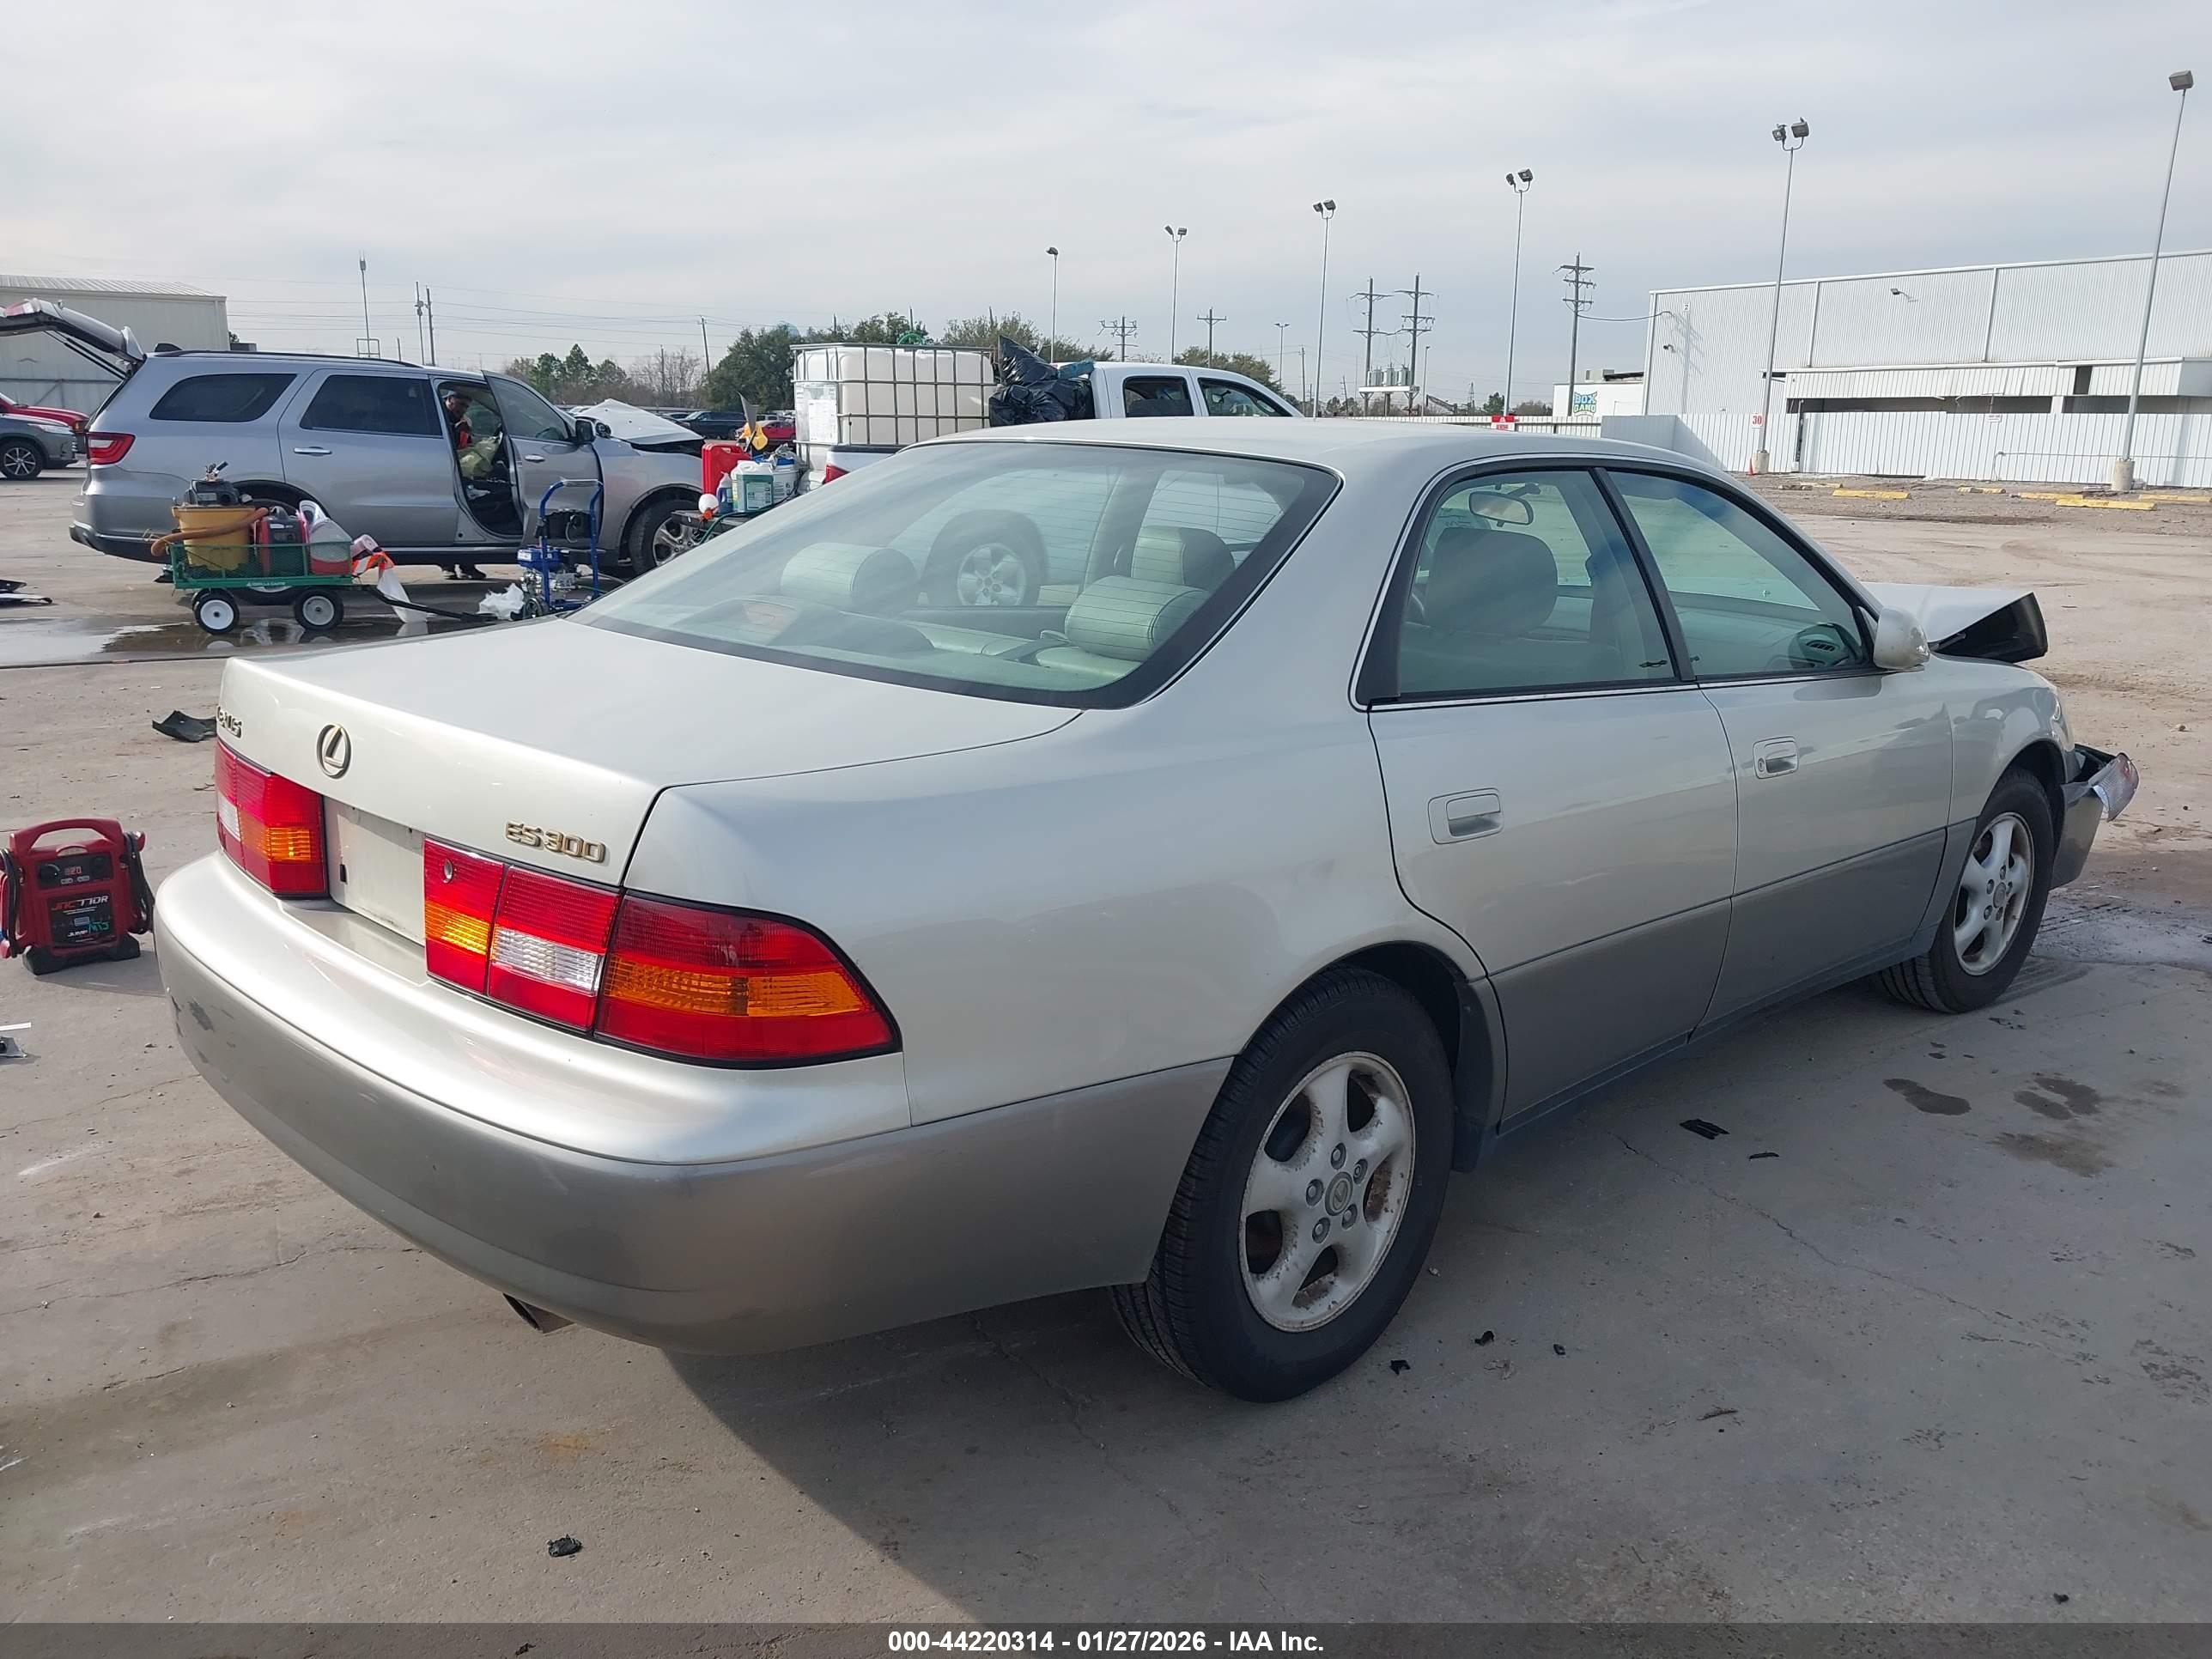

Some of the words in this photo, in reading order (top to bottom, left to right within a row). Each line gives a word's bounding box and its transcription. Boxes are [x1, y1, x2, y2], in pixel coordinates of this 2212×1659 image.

[1574, 393, 1596, 404] BOX
[1752, 416, 1763, 425] 30
[505, 821, 543, 848] ES
[544, 830, 606, 864] 300
